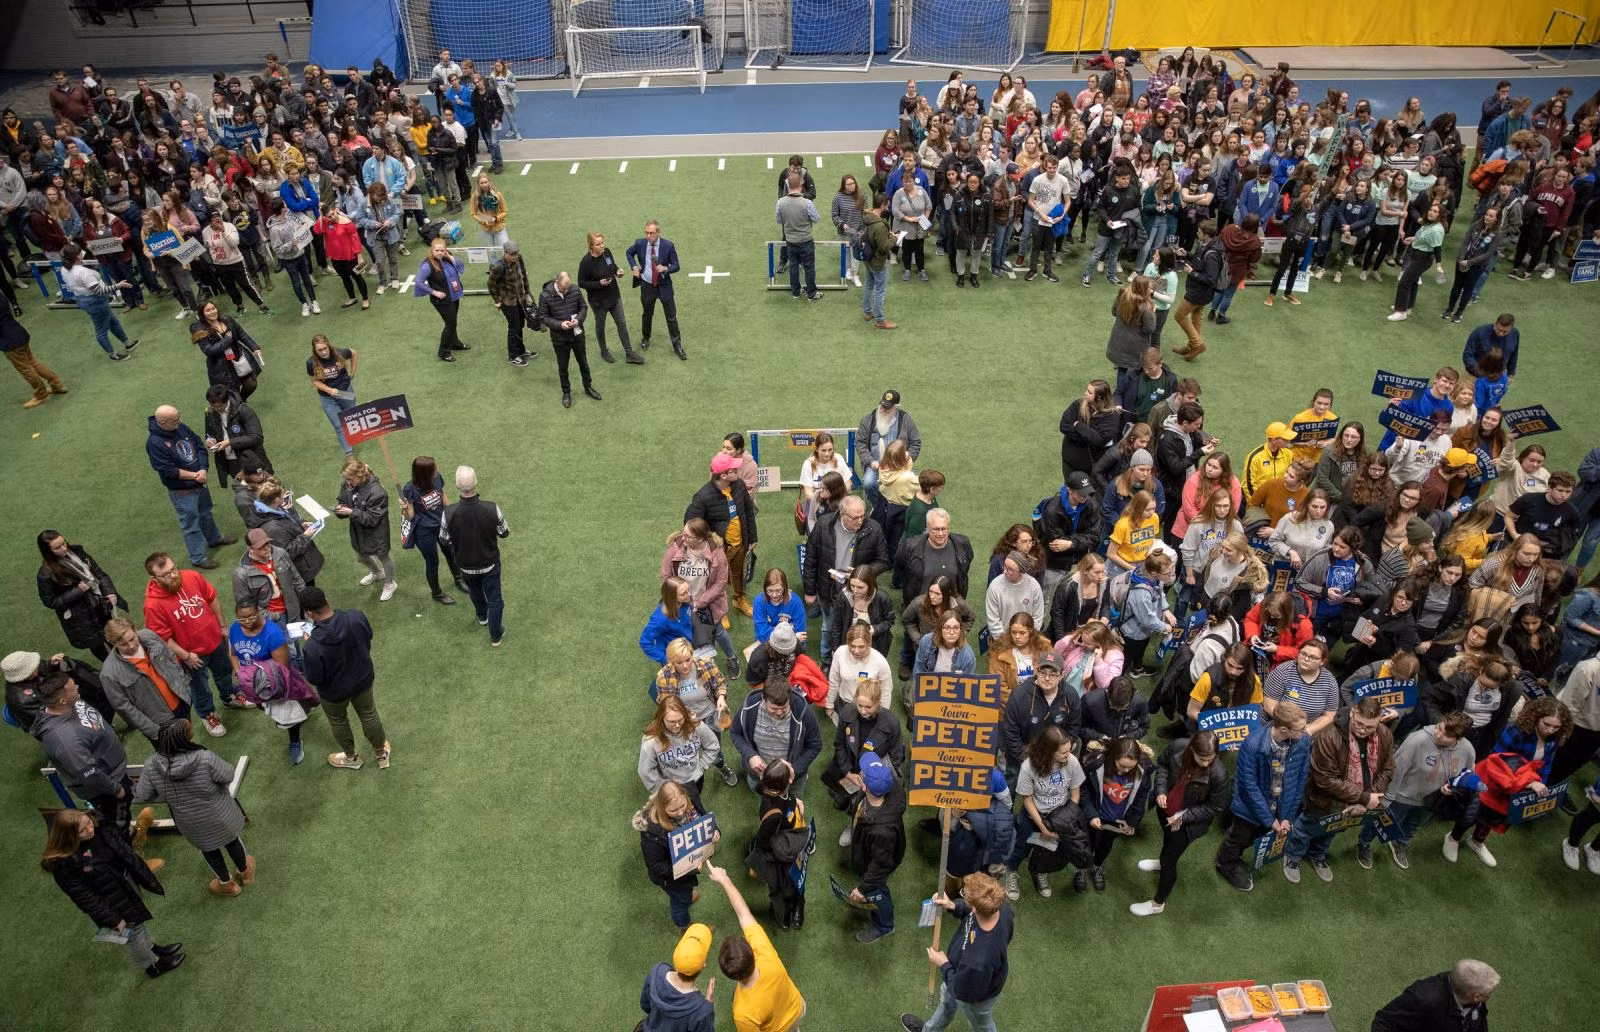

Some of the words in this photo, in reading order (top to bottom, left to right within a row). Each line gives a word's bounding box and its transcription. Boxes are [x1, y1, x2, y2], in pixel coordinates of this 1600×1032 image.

[150, 236, 176, 250] Bernie
[1377, 374, 1426, 388] STUDENTS
[1386, 386, 1410, 396] PETE
[344, 412, 362, 422] IOWA
[346, 406, 406, 436] BIDEN
[1388, 408, 1435, 430] STUDENTS
[1504, 409, 1546, 423] STUDENTS
[1294, 422, 1338, 432] STUDENTS
[1392, 422, 1416, 436] PETE
[1520, 422, 1544, 431] PETE
[1474, 448, 1496, 479] STUDENTS
[1132, 528, 1154, 541] PETE
[680, 566, 709, 577] BRECK
[1276, 571, 1288, 591] PETE
[680, 684, 696, 692] PETE
[919, 675, 998, 703] PETE
[1380, 694, 1401, 704] ETE
[75, 700, 92, 728] DRAKE
[940, 705, 976, 719] Iowa
[1200, 710, 1258, 728] STUDENTS
[916, 720, 994, 748] PETE
[1216, 728, 1246, 740] PETE
[938, 750, 972, 762] Iowa
[914, 764, 990, 790] PETE
[934, 792, 968, 804] Iowa
[1526, 800, 1554, 816] PETE
[672, 817, 713, 858] PETE
